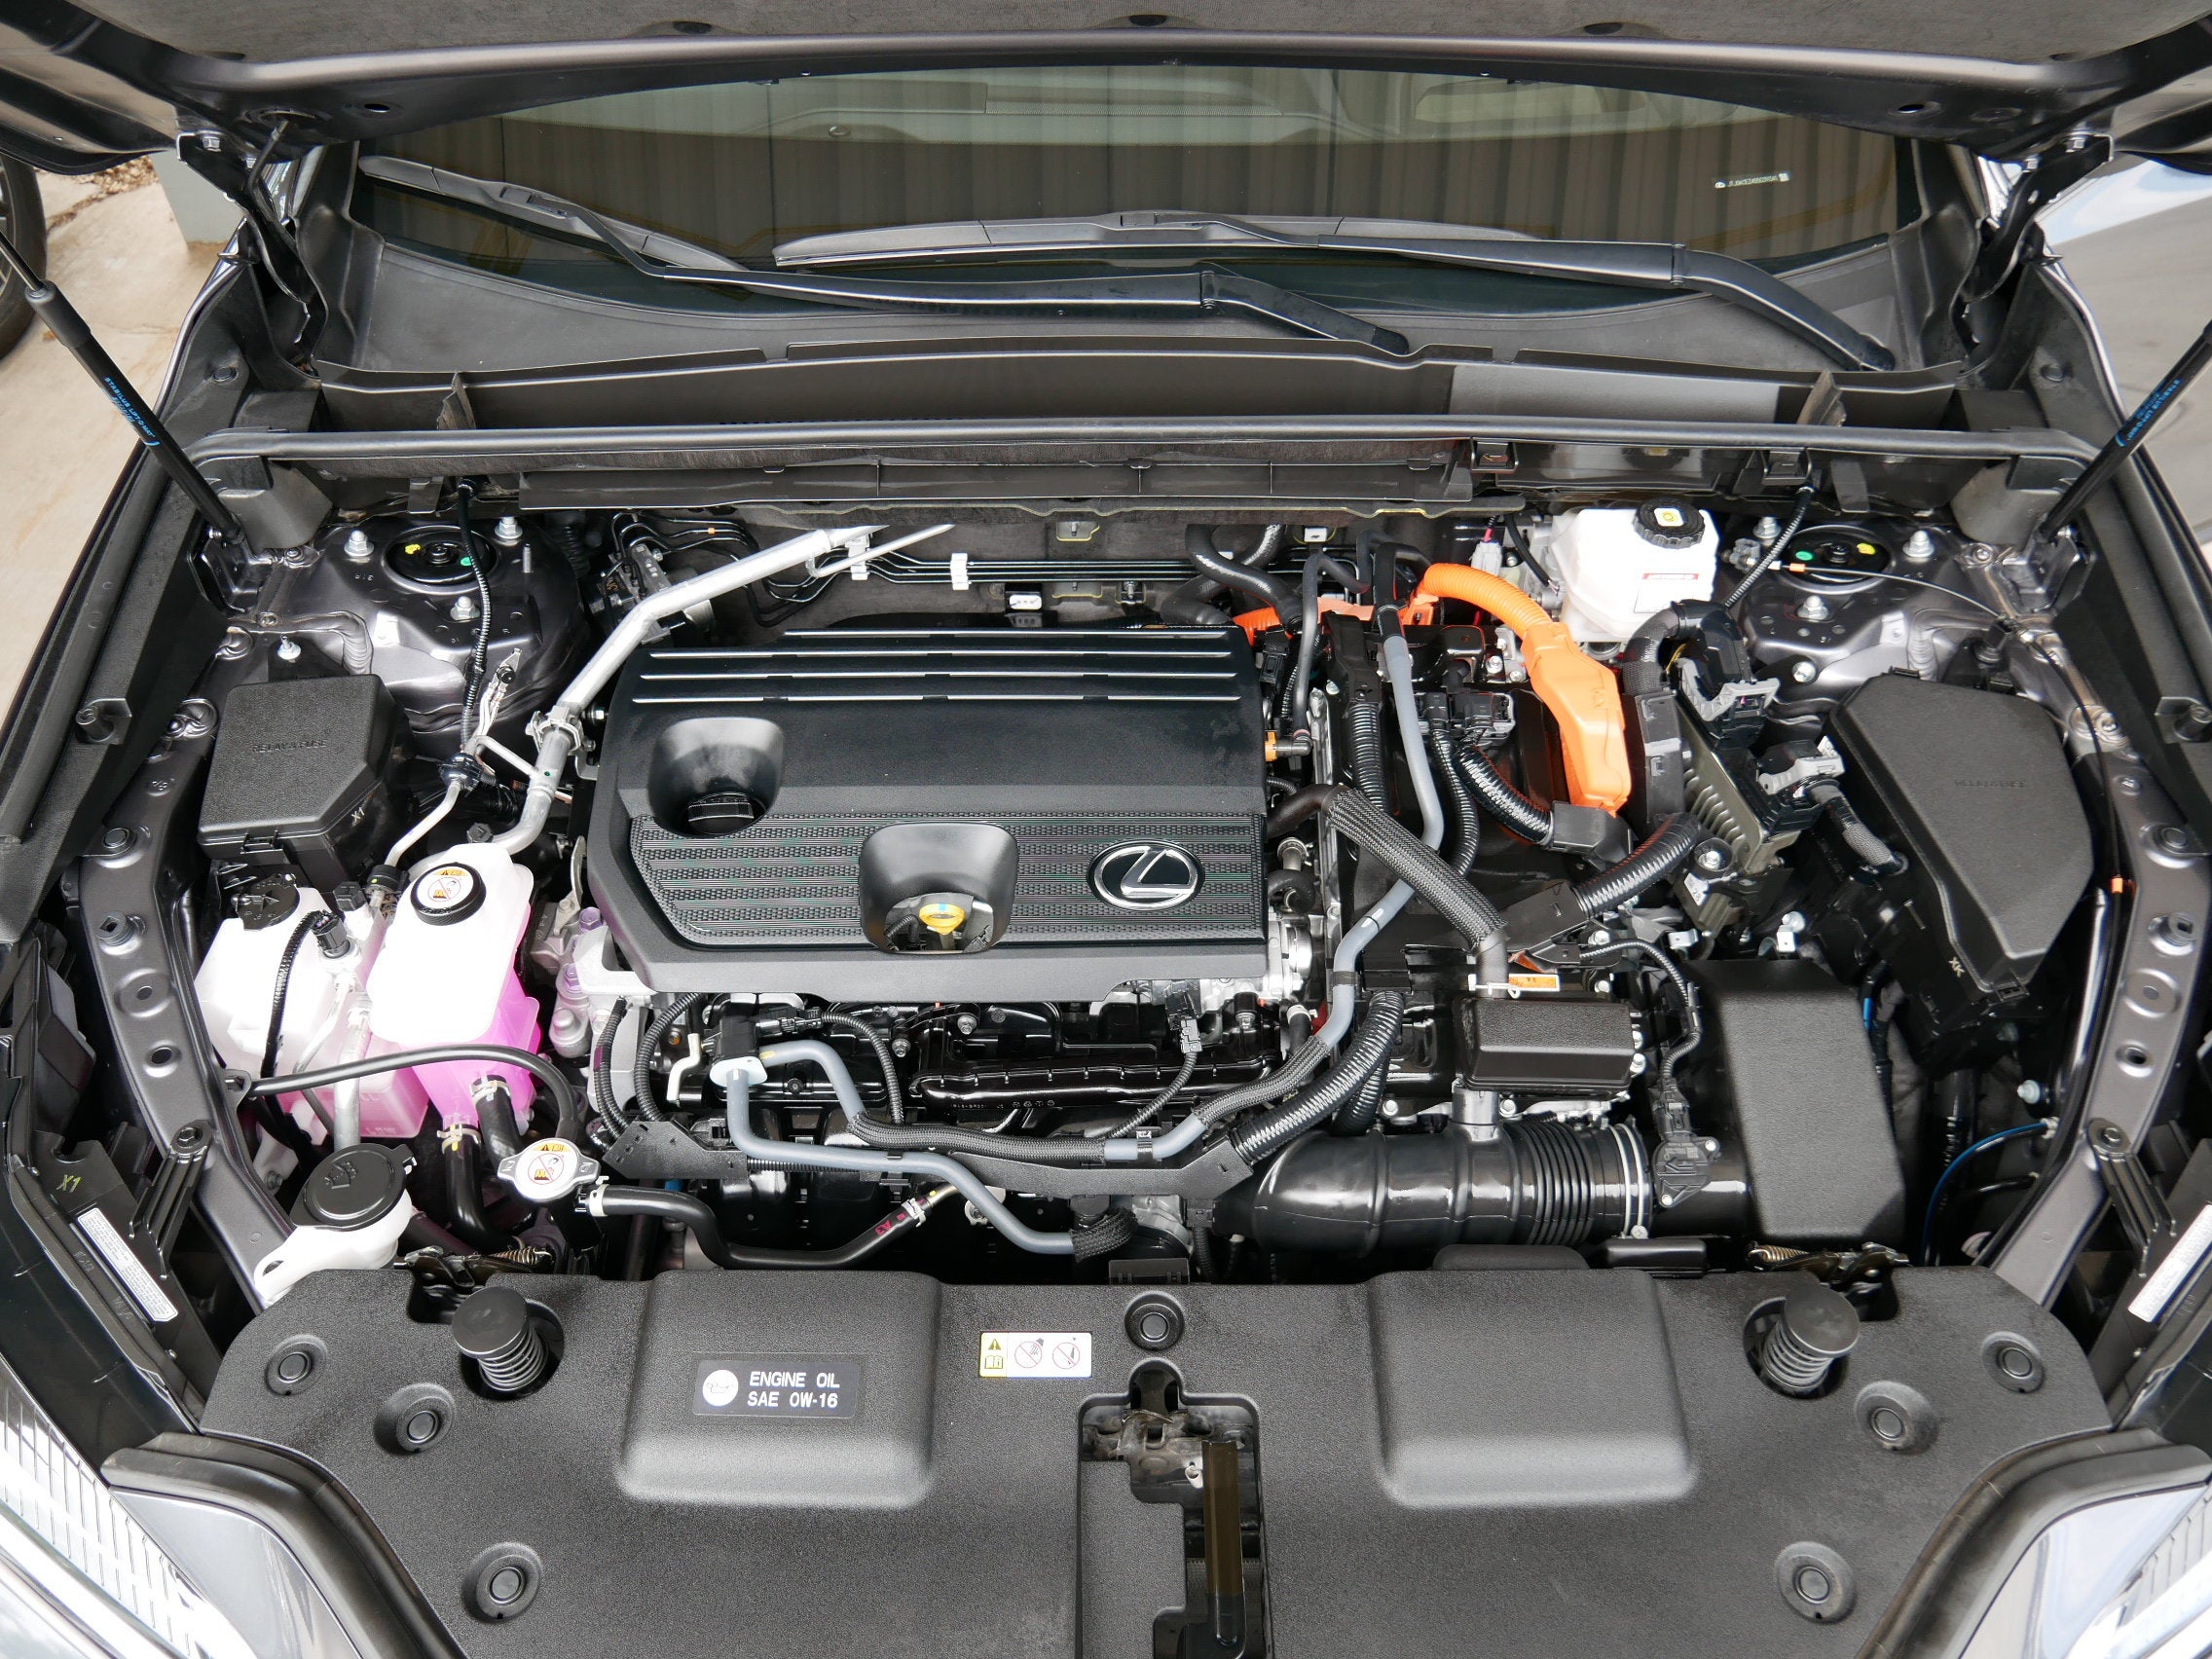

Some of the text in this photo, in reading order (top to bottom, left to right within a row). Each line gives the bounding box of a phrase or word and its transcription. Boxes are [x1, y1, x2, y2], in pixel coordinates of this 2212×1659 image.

[299, 739, 328, 749] FUSE
[750, 1371, 840, 1388] ENGINE OIL
[747, 1391, 780, 1407] SAE
